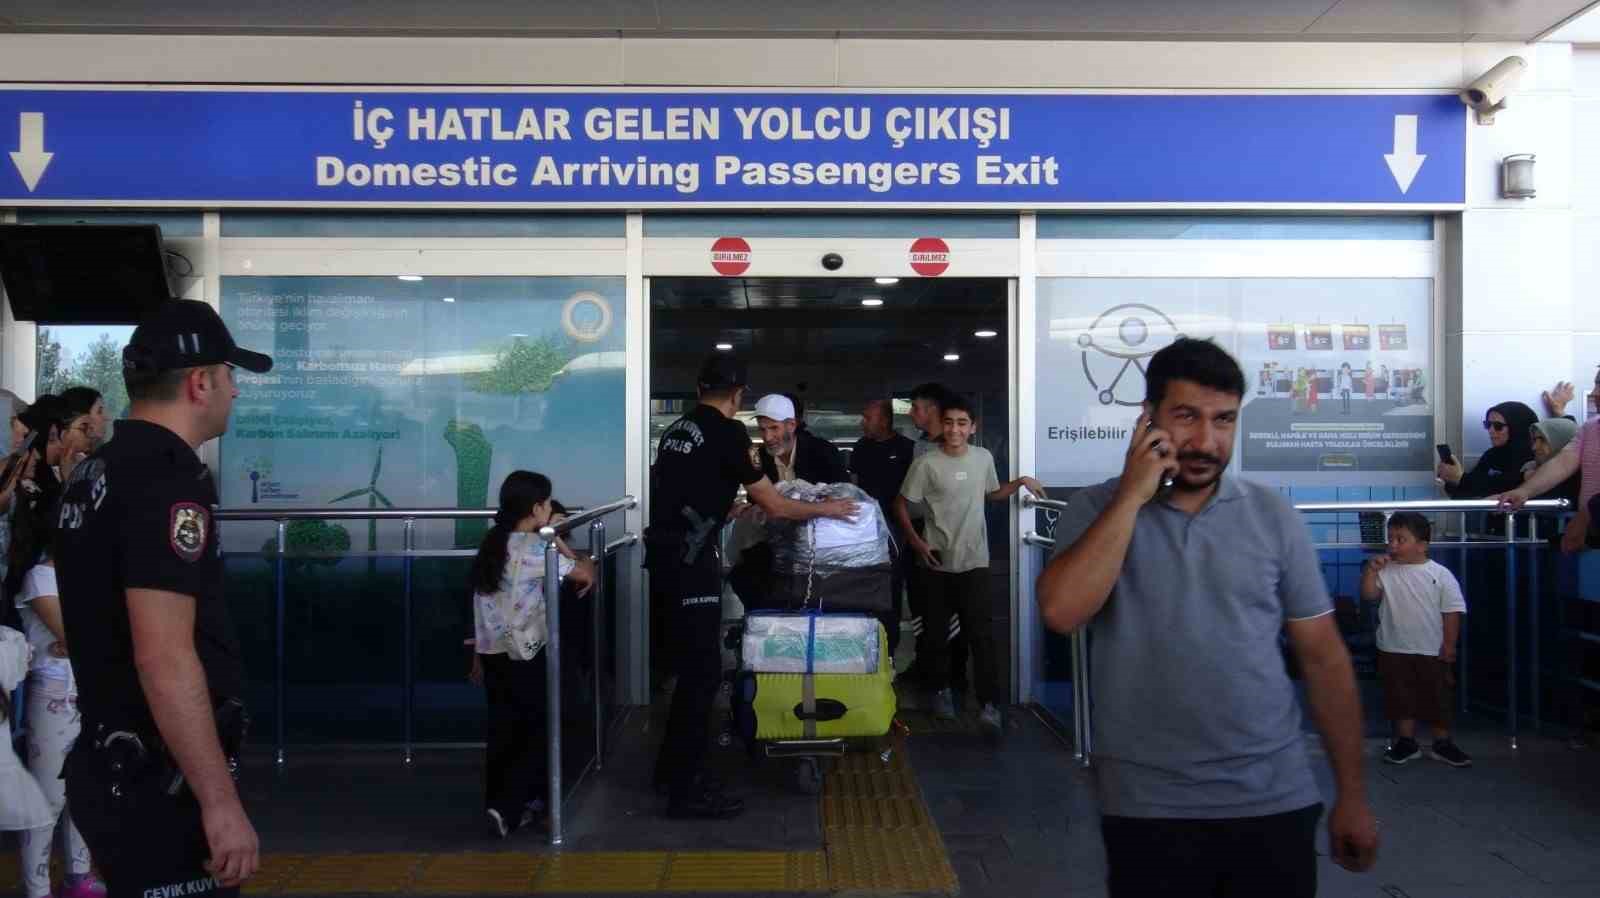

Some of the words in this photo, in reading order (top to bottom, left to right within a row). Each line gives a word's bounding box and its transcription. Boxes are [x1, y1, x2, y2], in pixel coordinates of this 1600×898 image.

[353, 100, 394, 148] İÇ
[408, 107, 571, 141] HATLAR
[584, 107, 720, 141] GELEN
[733, 107, 871, 140] YOLCU
[885, 107, 1010, 148] ÇIKIŞI
[316, 156, 518, 186] Domestic
[531, 155, 700, 193] Arriving
[715, 155, 961, 193] Passengers
[976, 155, 1059, 186] Exit
[1047, 426, 1127, 442] Erişilebilir
